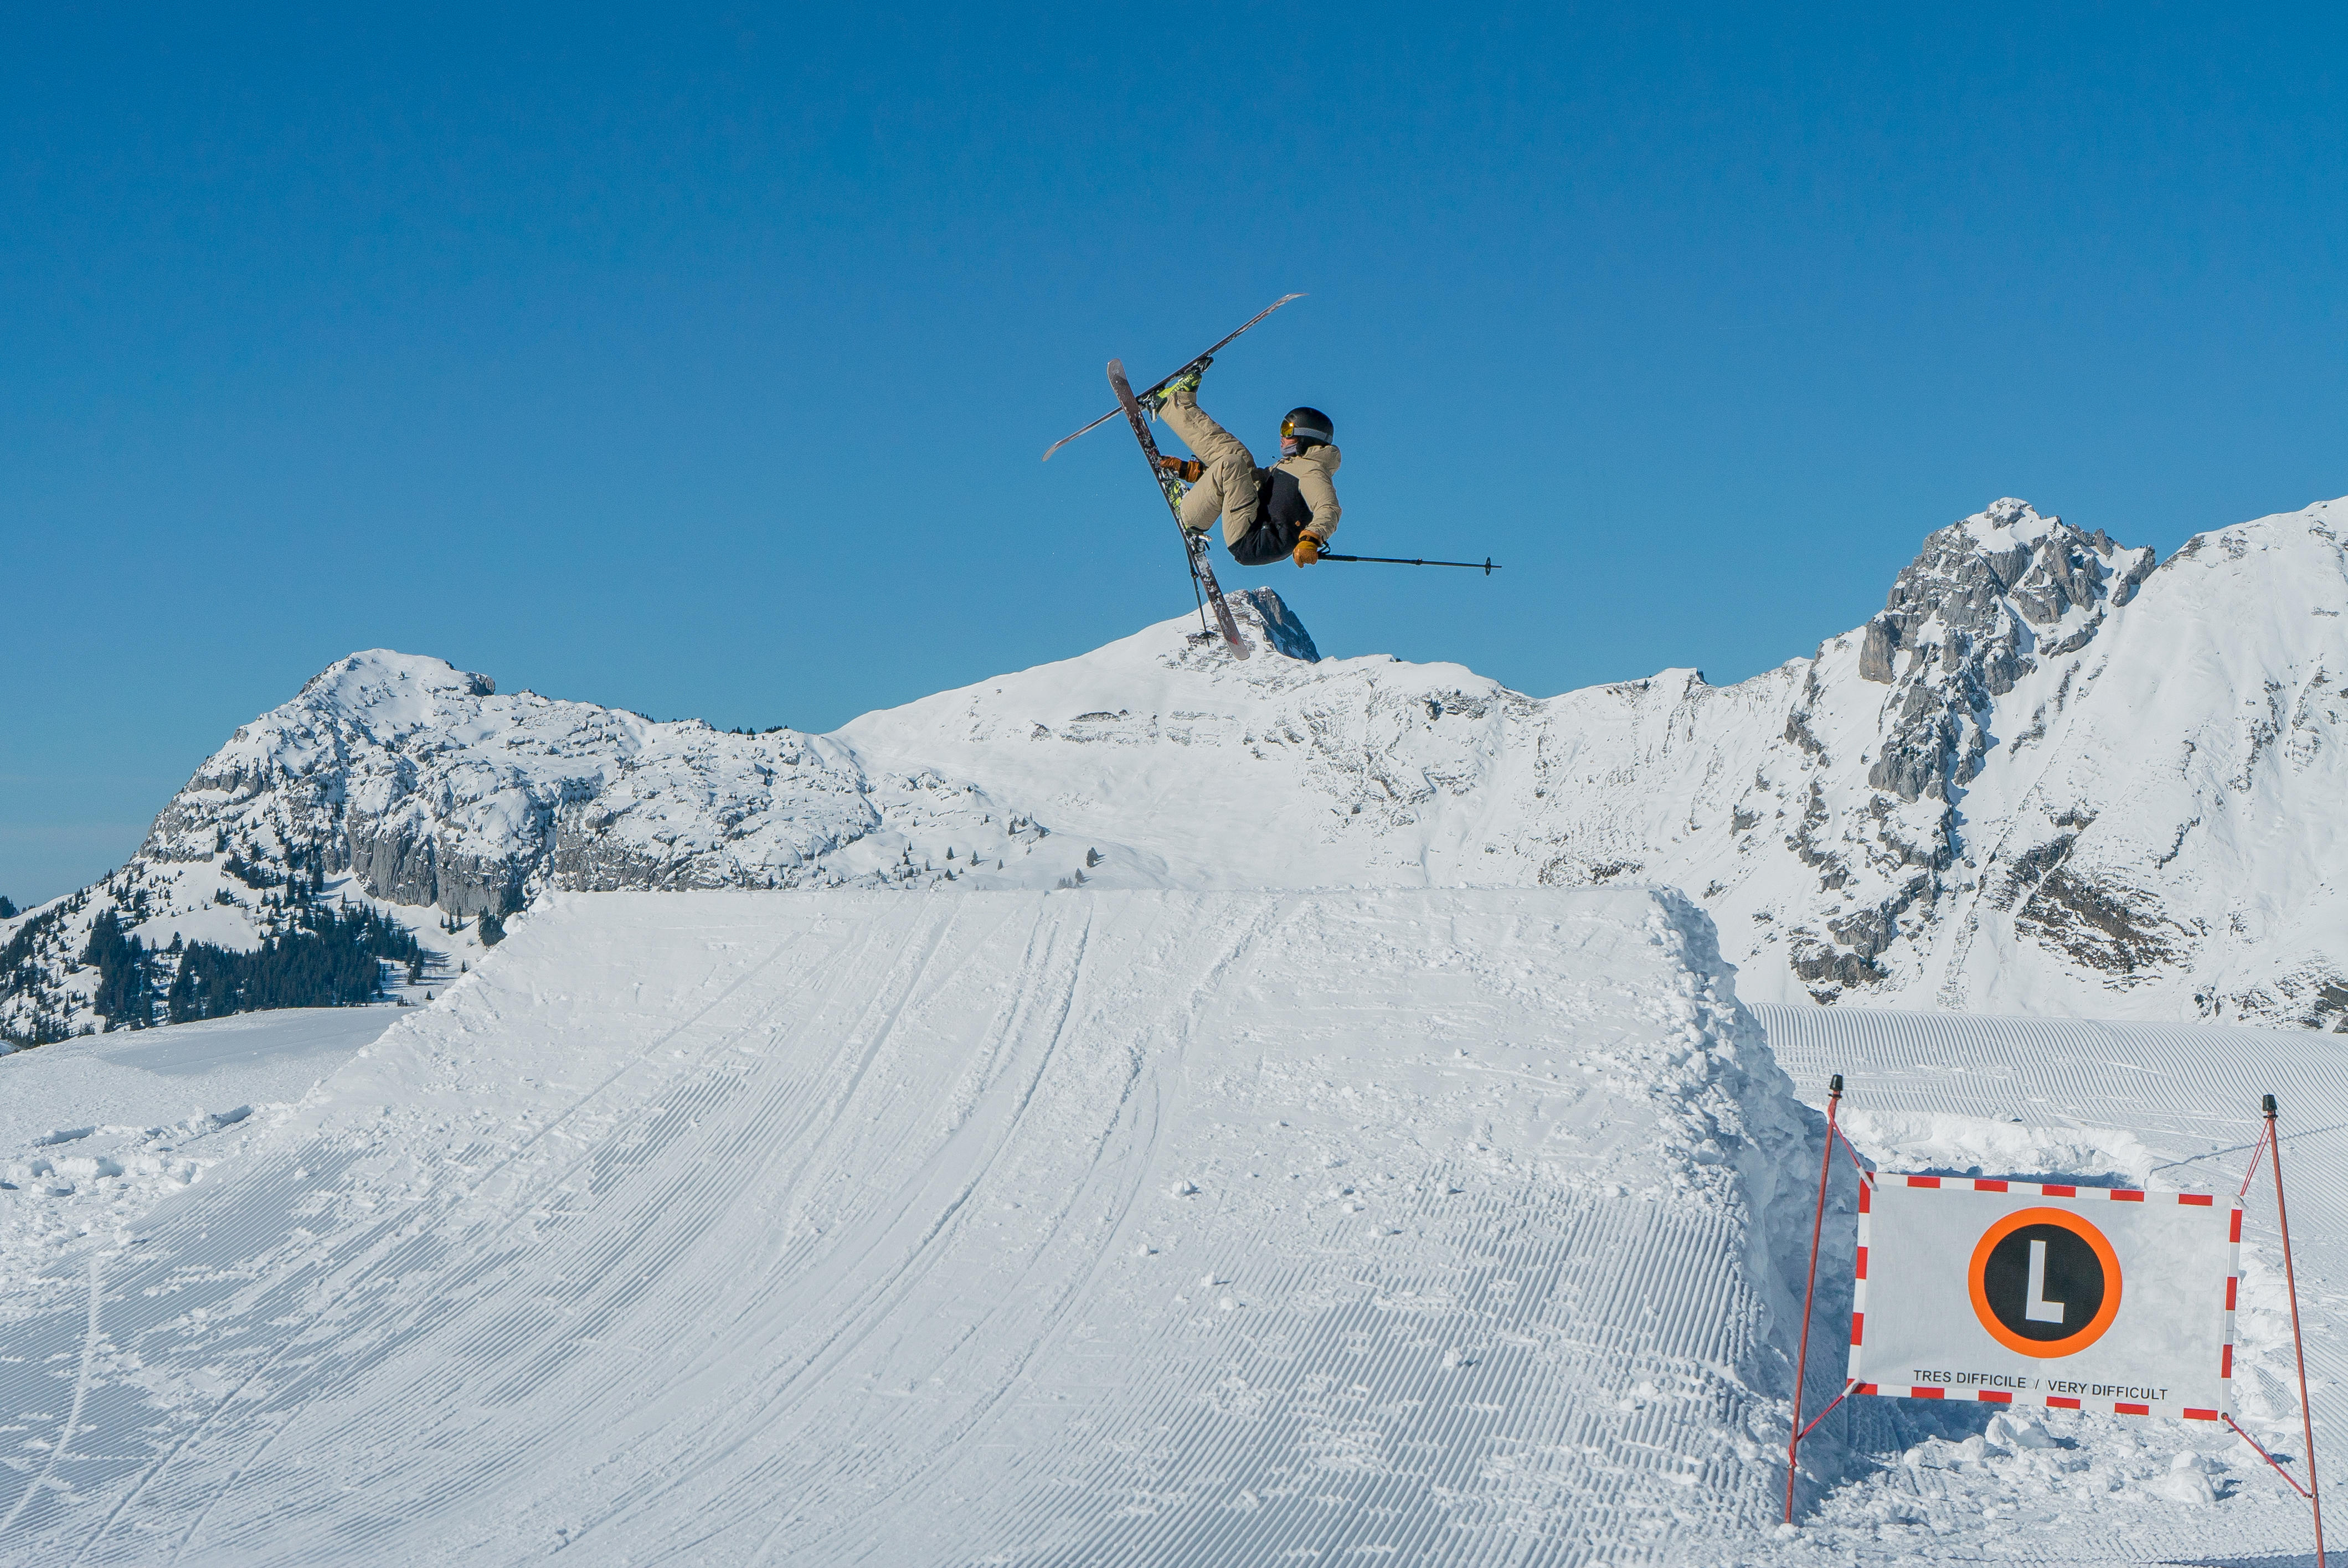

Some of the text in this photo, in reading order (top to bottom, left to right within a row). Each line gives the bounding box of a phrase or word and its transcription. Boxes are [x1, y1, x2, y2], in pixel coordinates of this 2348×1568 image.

[2025, 1240, 2065, 1324] L
[1913, 1370, 2168, 1400] TRES DIFFICILE / VERY DIFFICULT
